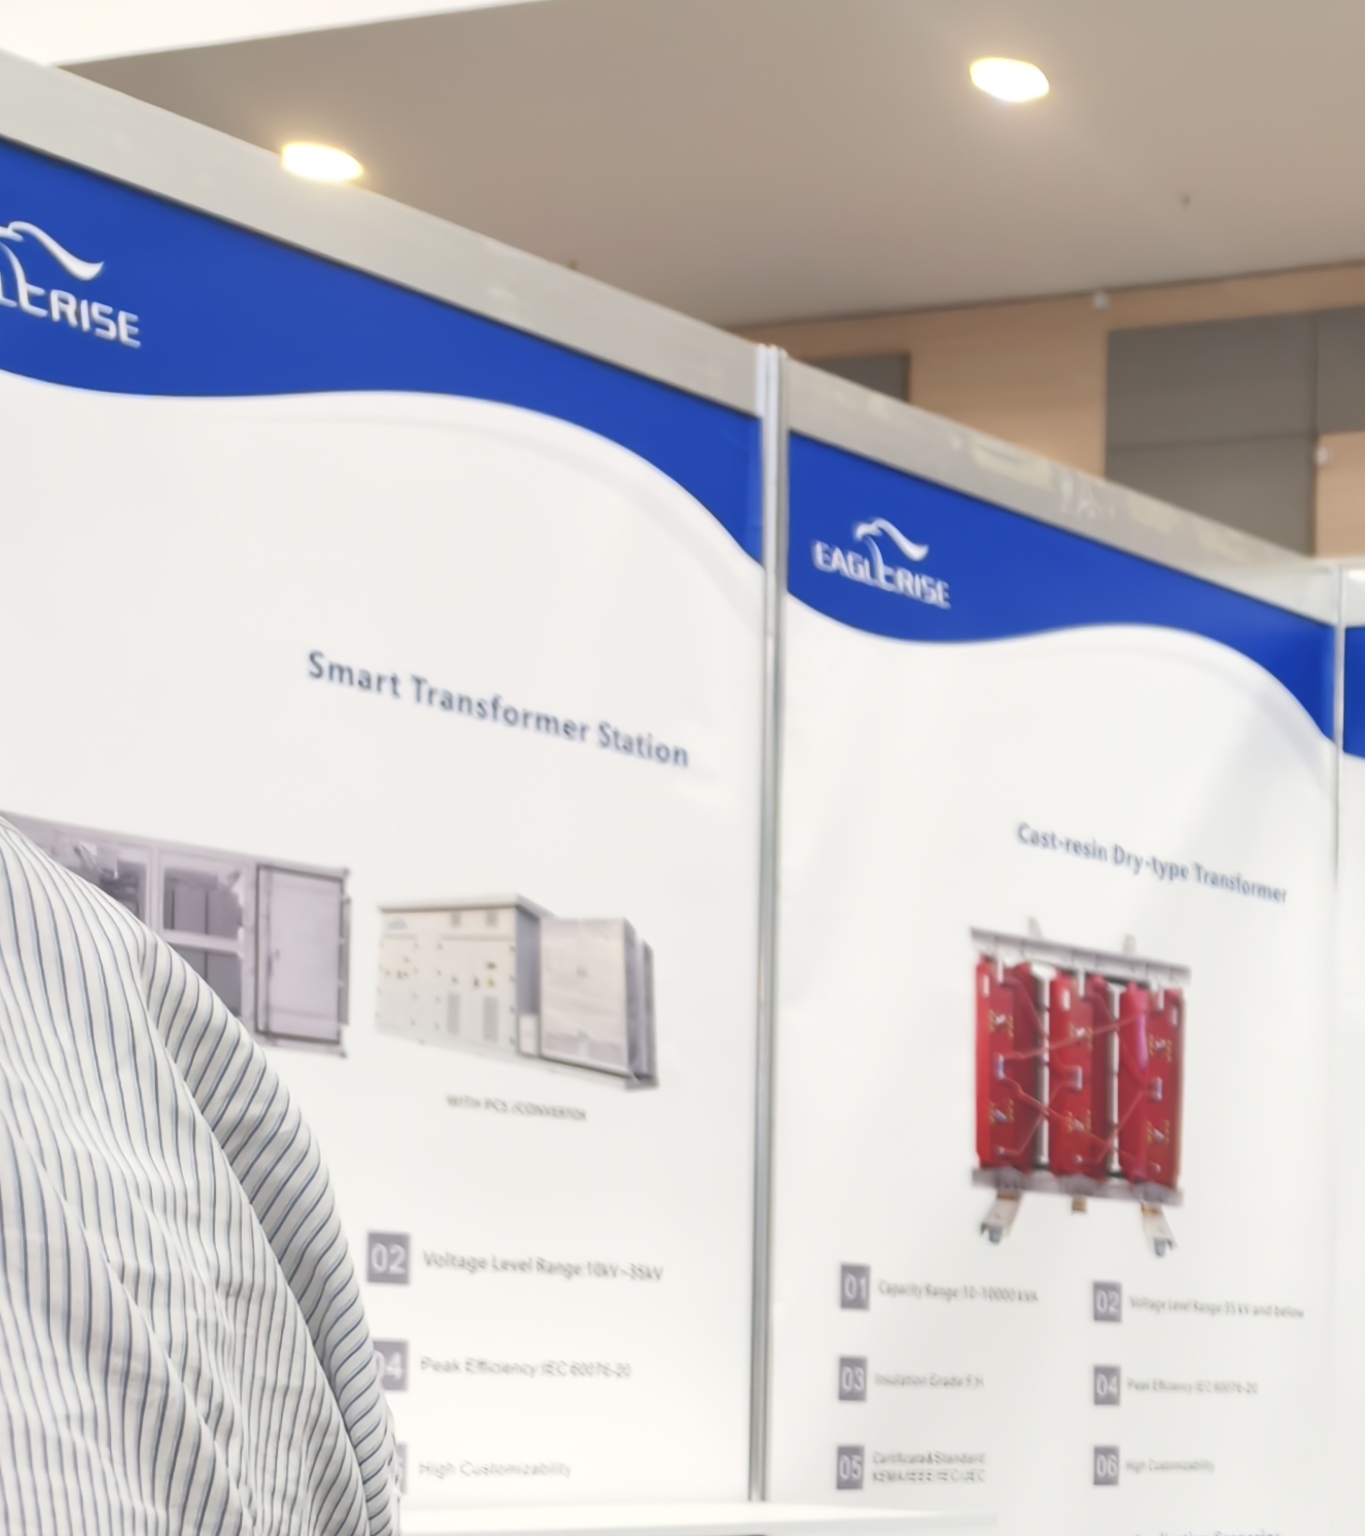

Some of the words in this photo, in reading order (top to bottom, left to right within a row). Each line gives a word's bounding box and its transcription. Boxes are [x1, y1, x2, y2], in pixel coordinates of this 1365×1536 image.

[0, 280, 142, 349] LERISE
[811, 539, 952, 610] EAGLERISE
[308, 650, 401, 698] Smart
[411, 674, 590, 744] Transformer
[599, 719, 690, 768] Station
[1016, 821, 1107, 863] Cast-resin
[1113, 843, 1190, 885] Dry-type
[1194, 861, 1288, 904] Transformer
[370, 1242, 407, 1275] 02
[422, 1249, 487, 1275] Voltage
[491, 1255, 533, 1274] Level
[844, 1272, 867, 1300] 01
[1095, 1288, 1120, 1313] 02
[420, 1355, 461, 1374] Peak
[841, 1365, 866, 1394] 03
[1095, 1371, 1119, 1397] 04
[838, 1453, 863, 1481] 05
[1095, 1453, 1119, 1478] 06
